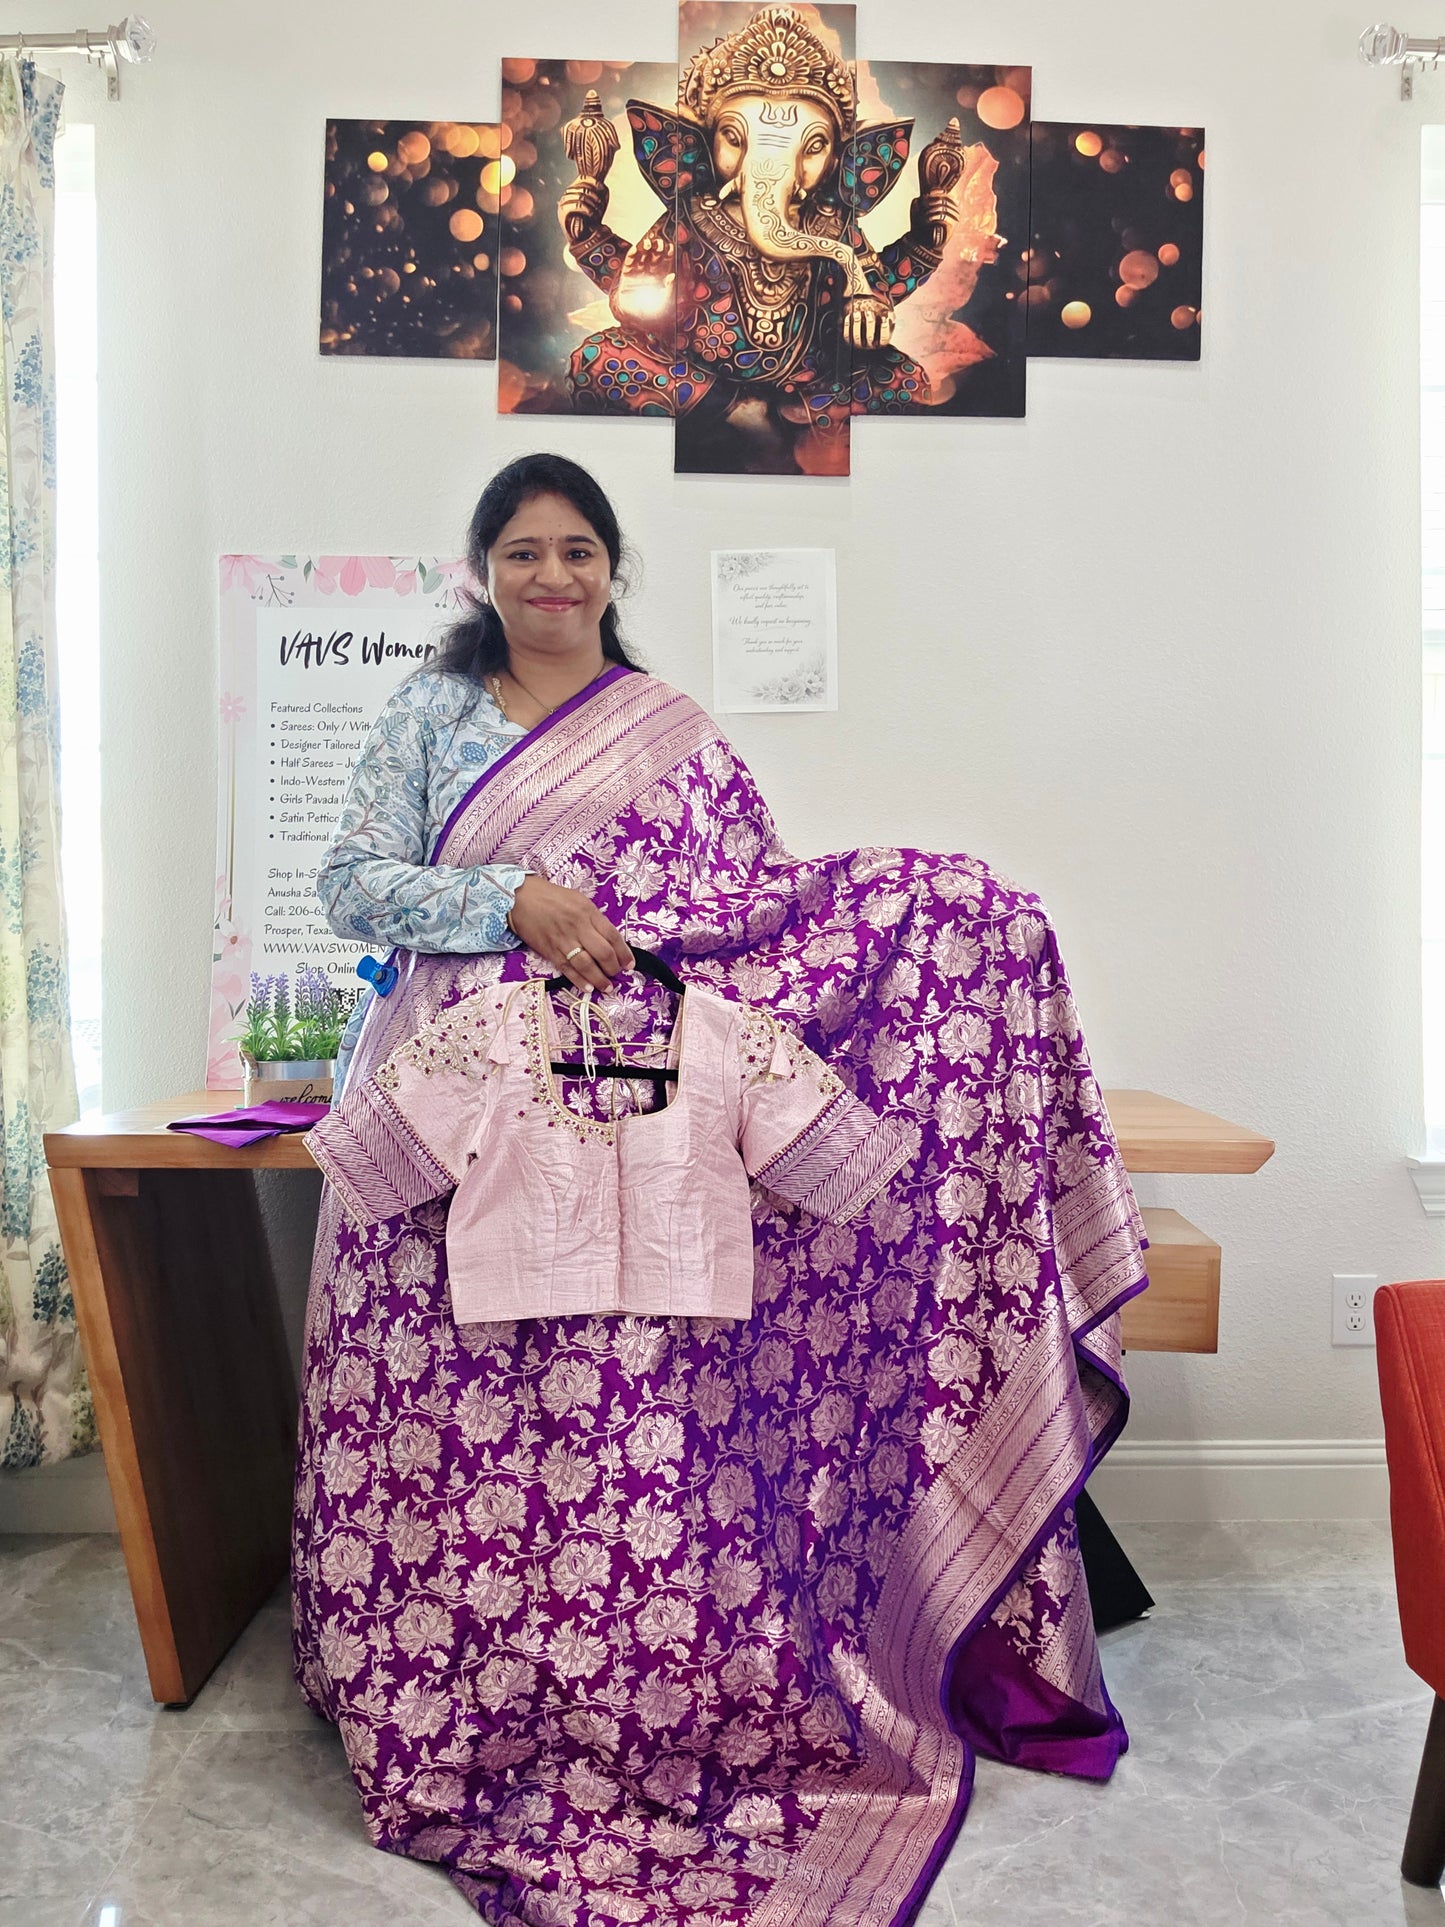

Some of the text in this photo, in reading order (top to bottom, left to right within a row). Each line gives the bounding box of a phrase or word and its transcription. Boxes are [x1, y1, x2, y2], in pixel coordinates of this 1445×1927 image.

[279, 630, 354, 669] VAVS
[270, 702, 363, 714] Featured Collections
[280, 720, 315, 732] Sarees:
[317, 721, 339, 735] Only
[280, 739, 361, 752] Designer Tailored
[280, 757, 301, 768] Half
[302, 757, 334, 768] Sarees
[280, 775, 345, 787] Indo-Western
[280, 793, 303, 804] Girls
[305, 793, 339, 805] Pavada
[279, 811, 340, 823] Satin Pettico
[279, 830, 330, 842] Traditional
[268, 868, 320, 882] Shop In-S
[267, 886, 318, 898] Anusha Sa
[264, 906, 286, 917] Call:
[263, 924, 304, 938] Prosper,
[327, 961, 356, 974] Onlin
